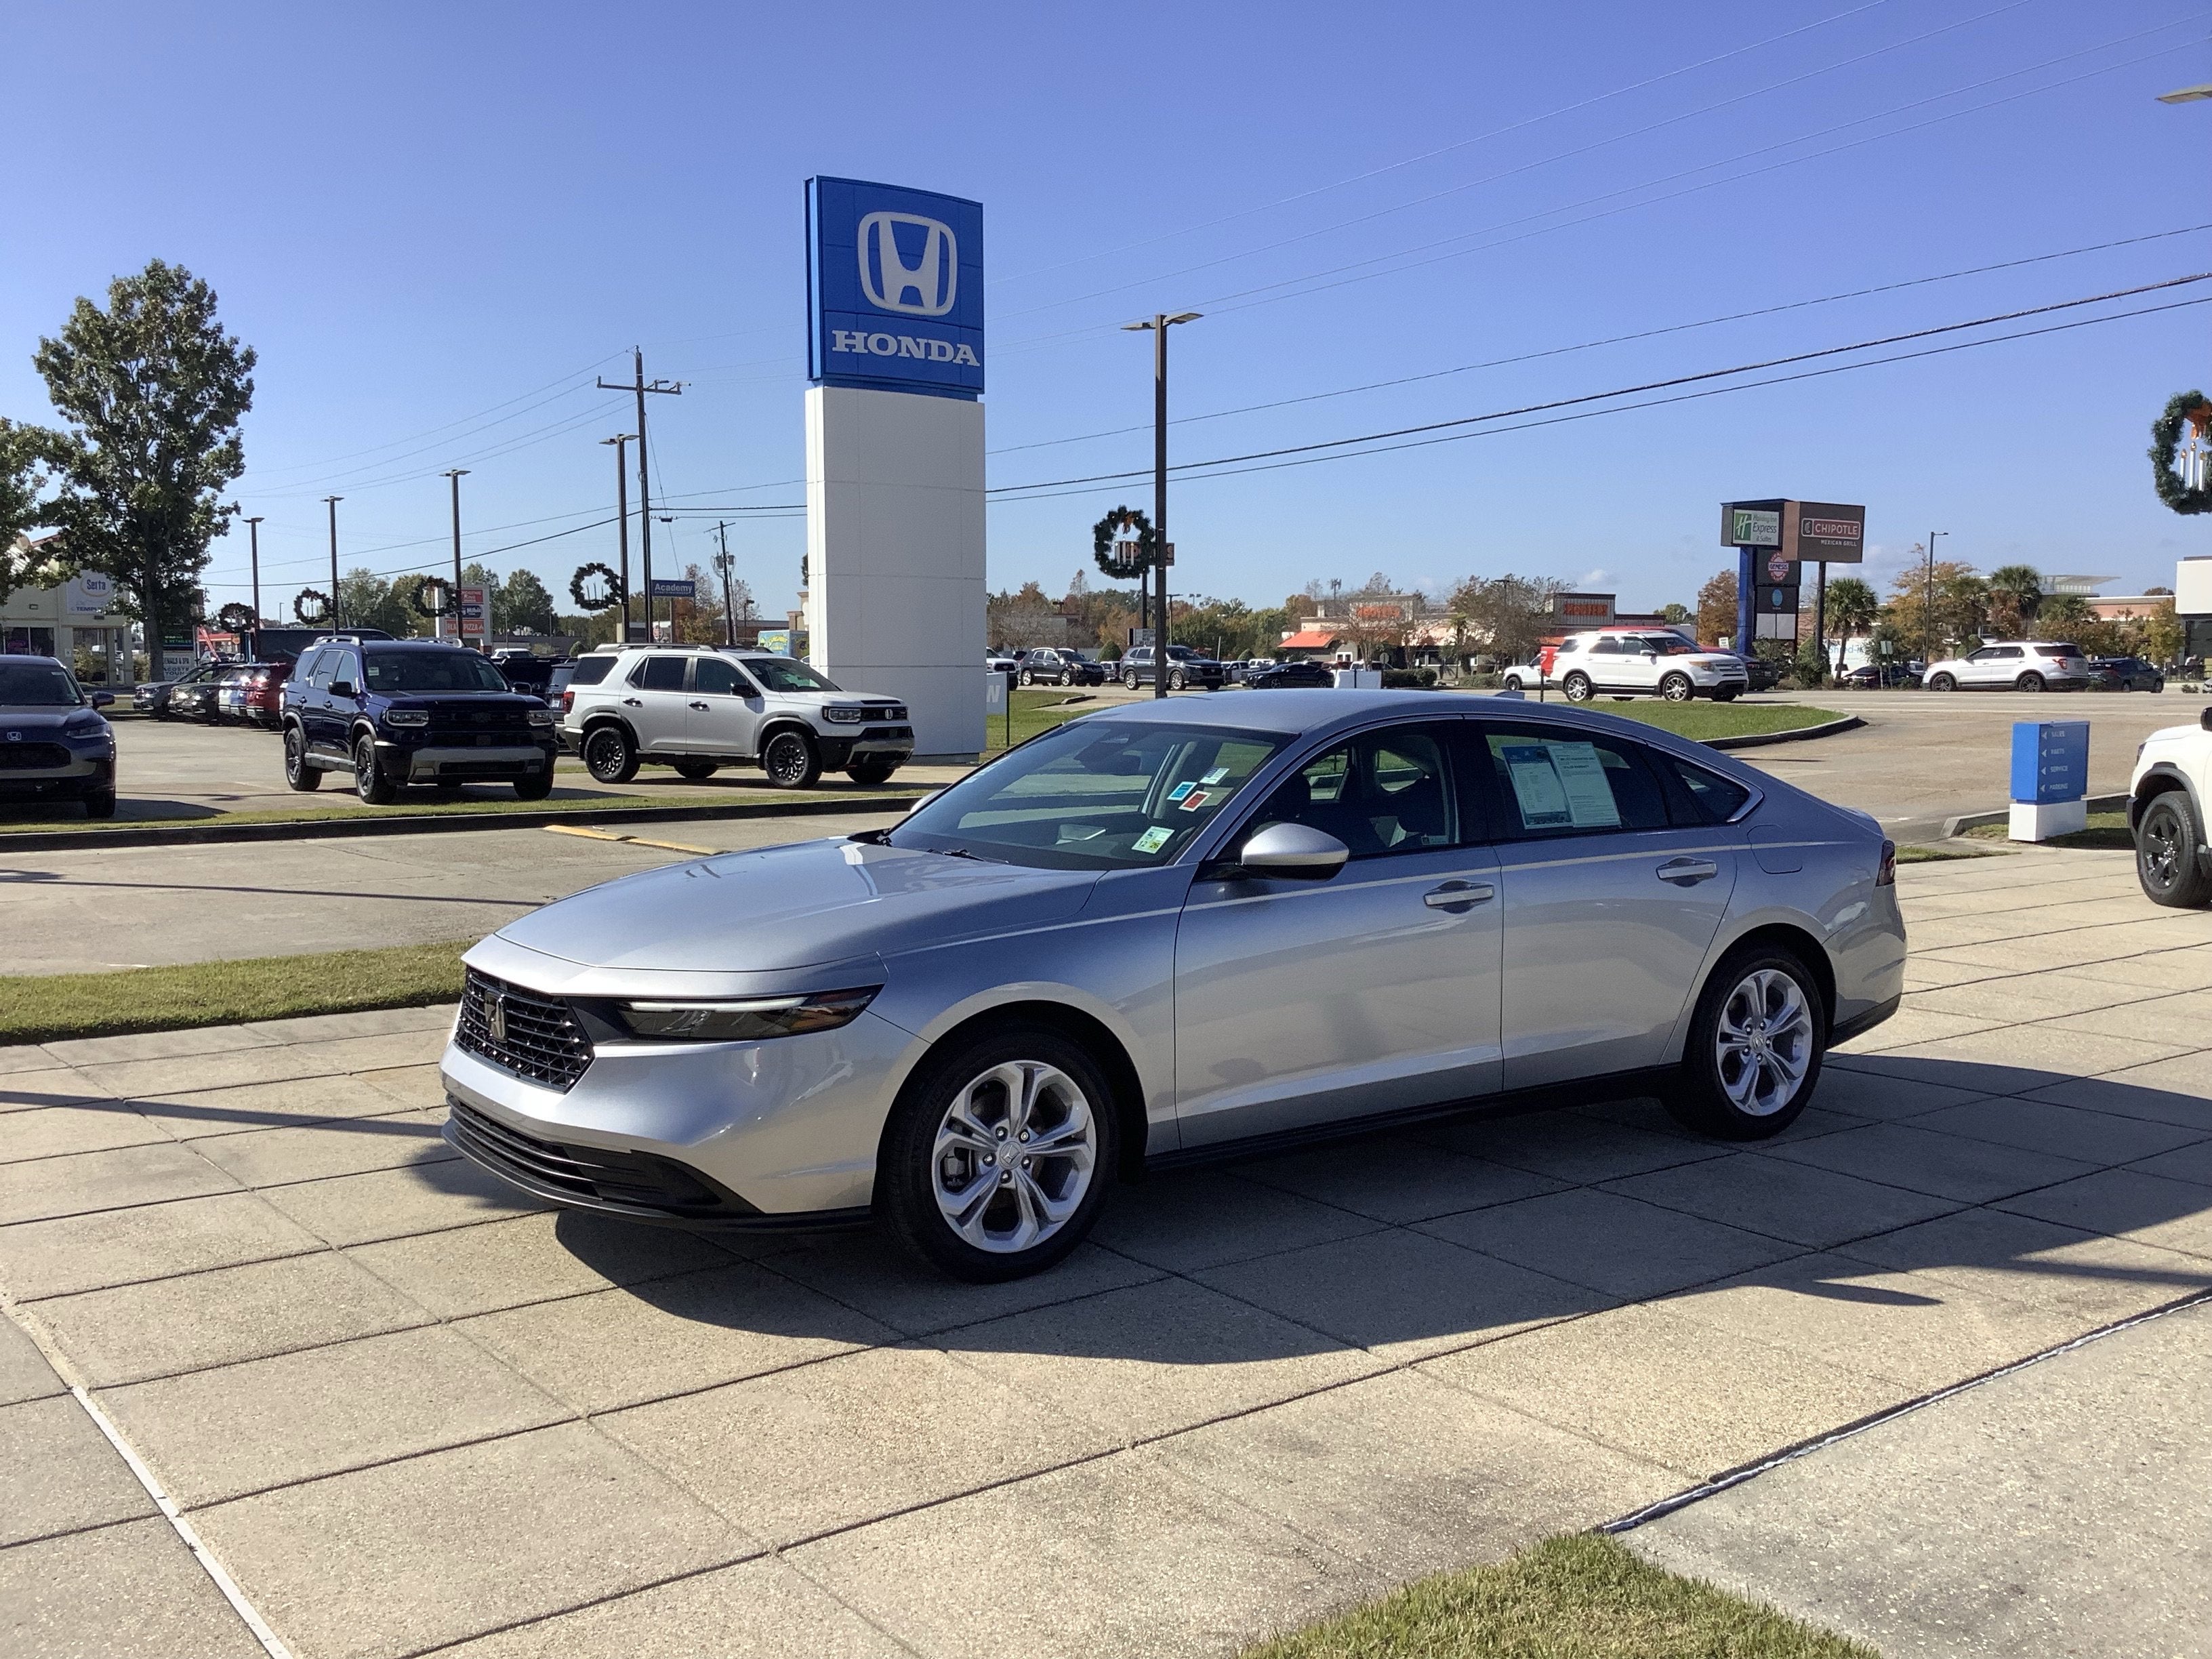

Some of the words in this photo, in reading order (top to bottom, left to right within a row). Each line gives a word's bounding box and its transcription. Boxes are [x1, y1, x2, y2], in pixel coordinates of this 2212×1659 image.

[832, 329, 981, 367] HONDA
[1753, 523, 1777, 535] Express
[1815, 523, 1858, 535] CHIPOTLE
[87, 579, 106, 590] Serta
[655, 583, 693, 594] Academy
